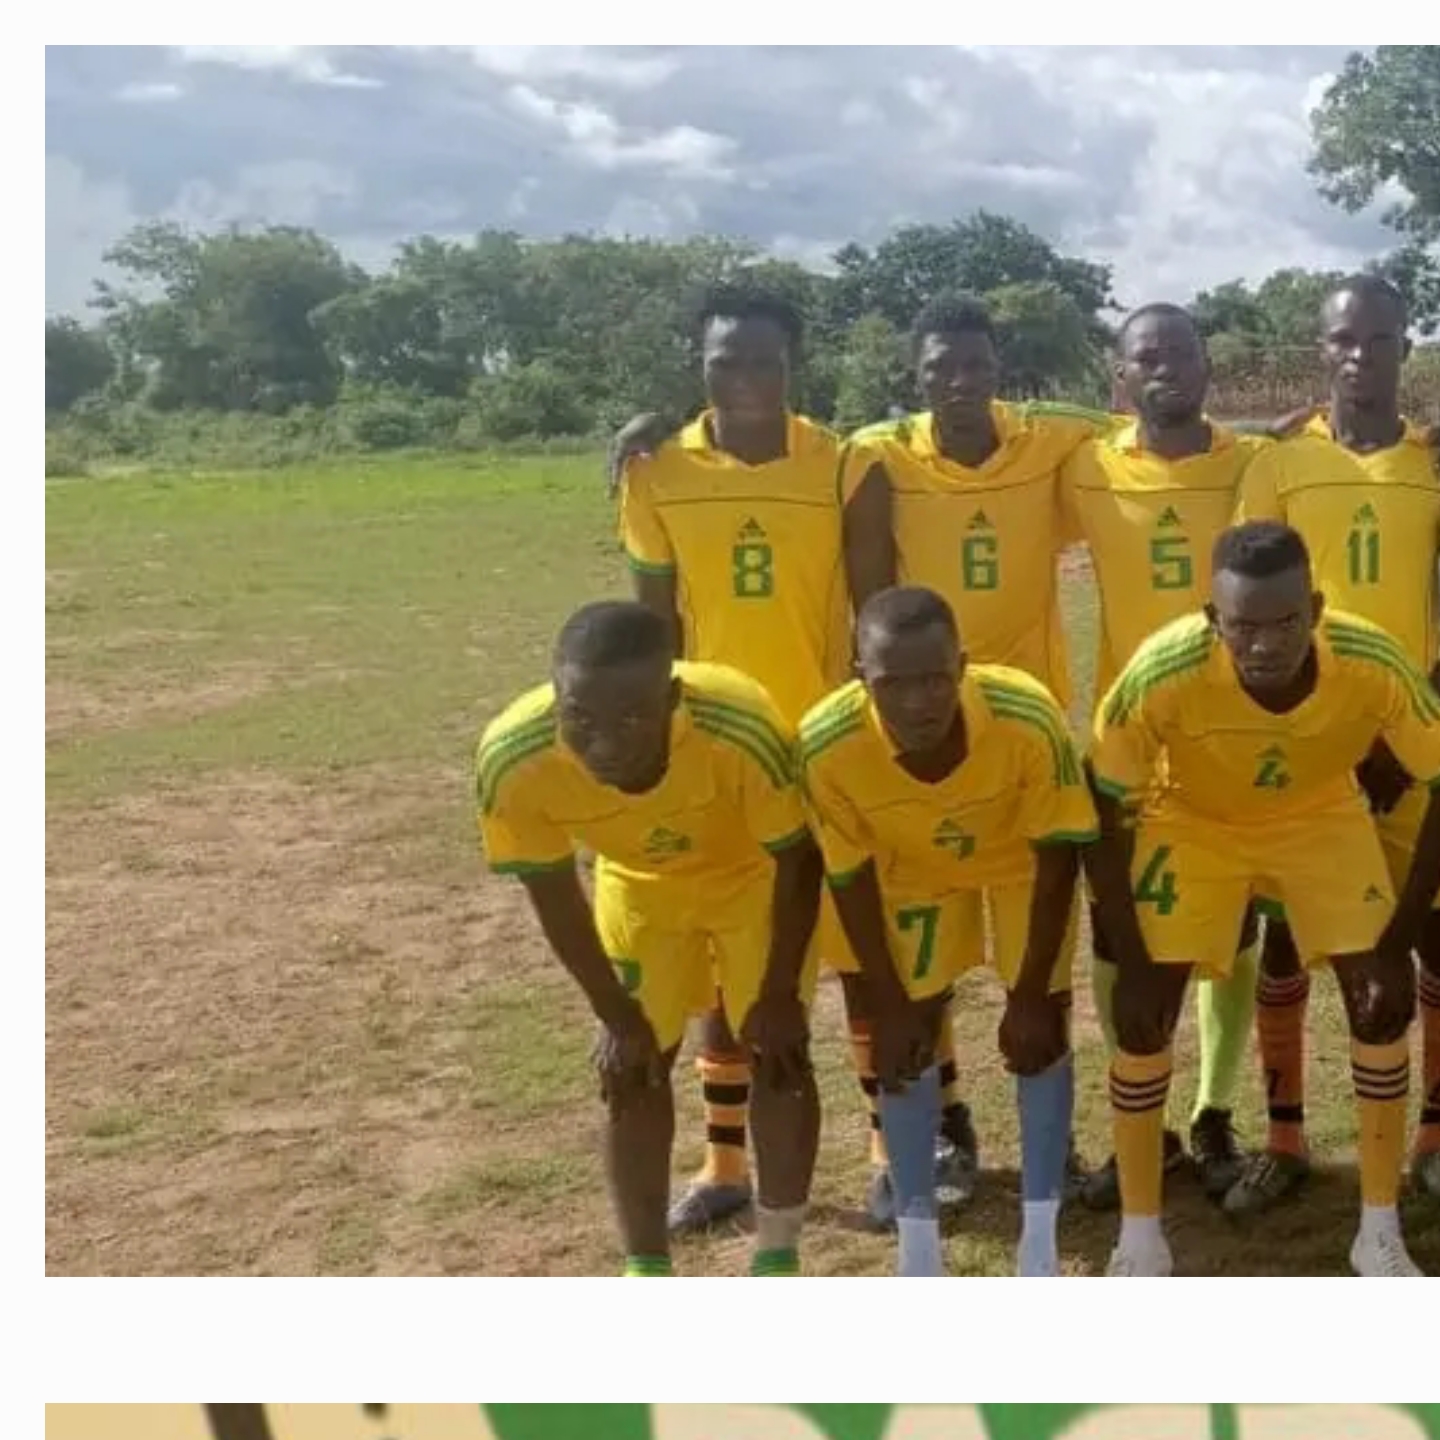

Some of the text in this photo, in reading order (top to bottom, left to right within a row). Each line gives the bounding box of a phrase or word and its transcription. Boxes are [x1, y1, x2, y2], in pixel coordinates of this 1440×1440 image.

[732, 543, 774, 598] 8
[961, 535, 998, 591] 6
[1151, 537, 1192, 590] 5
[1347, 529, 1380, 584] 11
[1135, 845, 1178, 916] 4
[896, 905, 942, 980] 7
